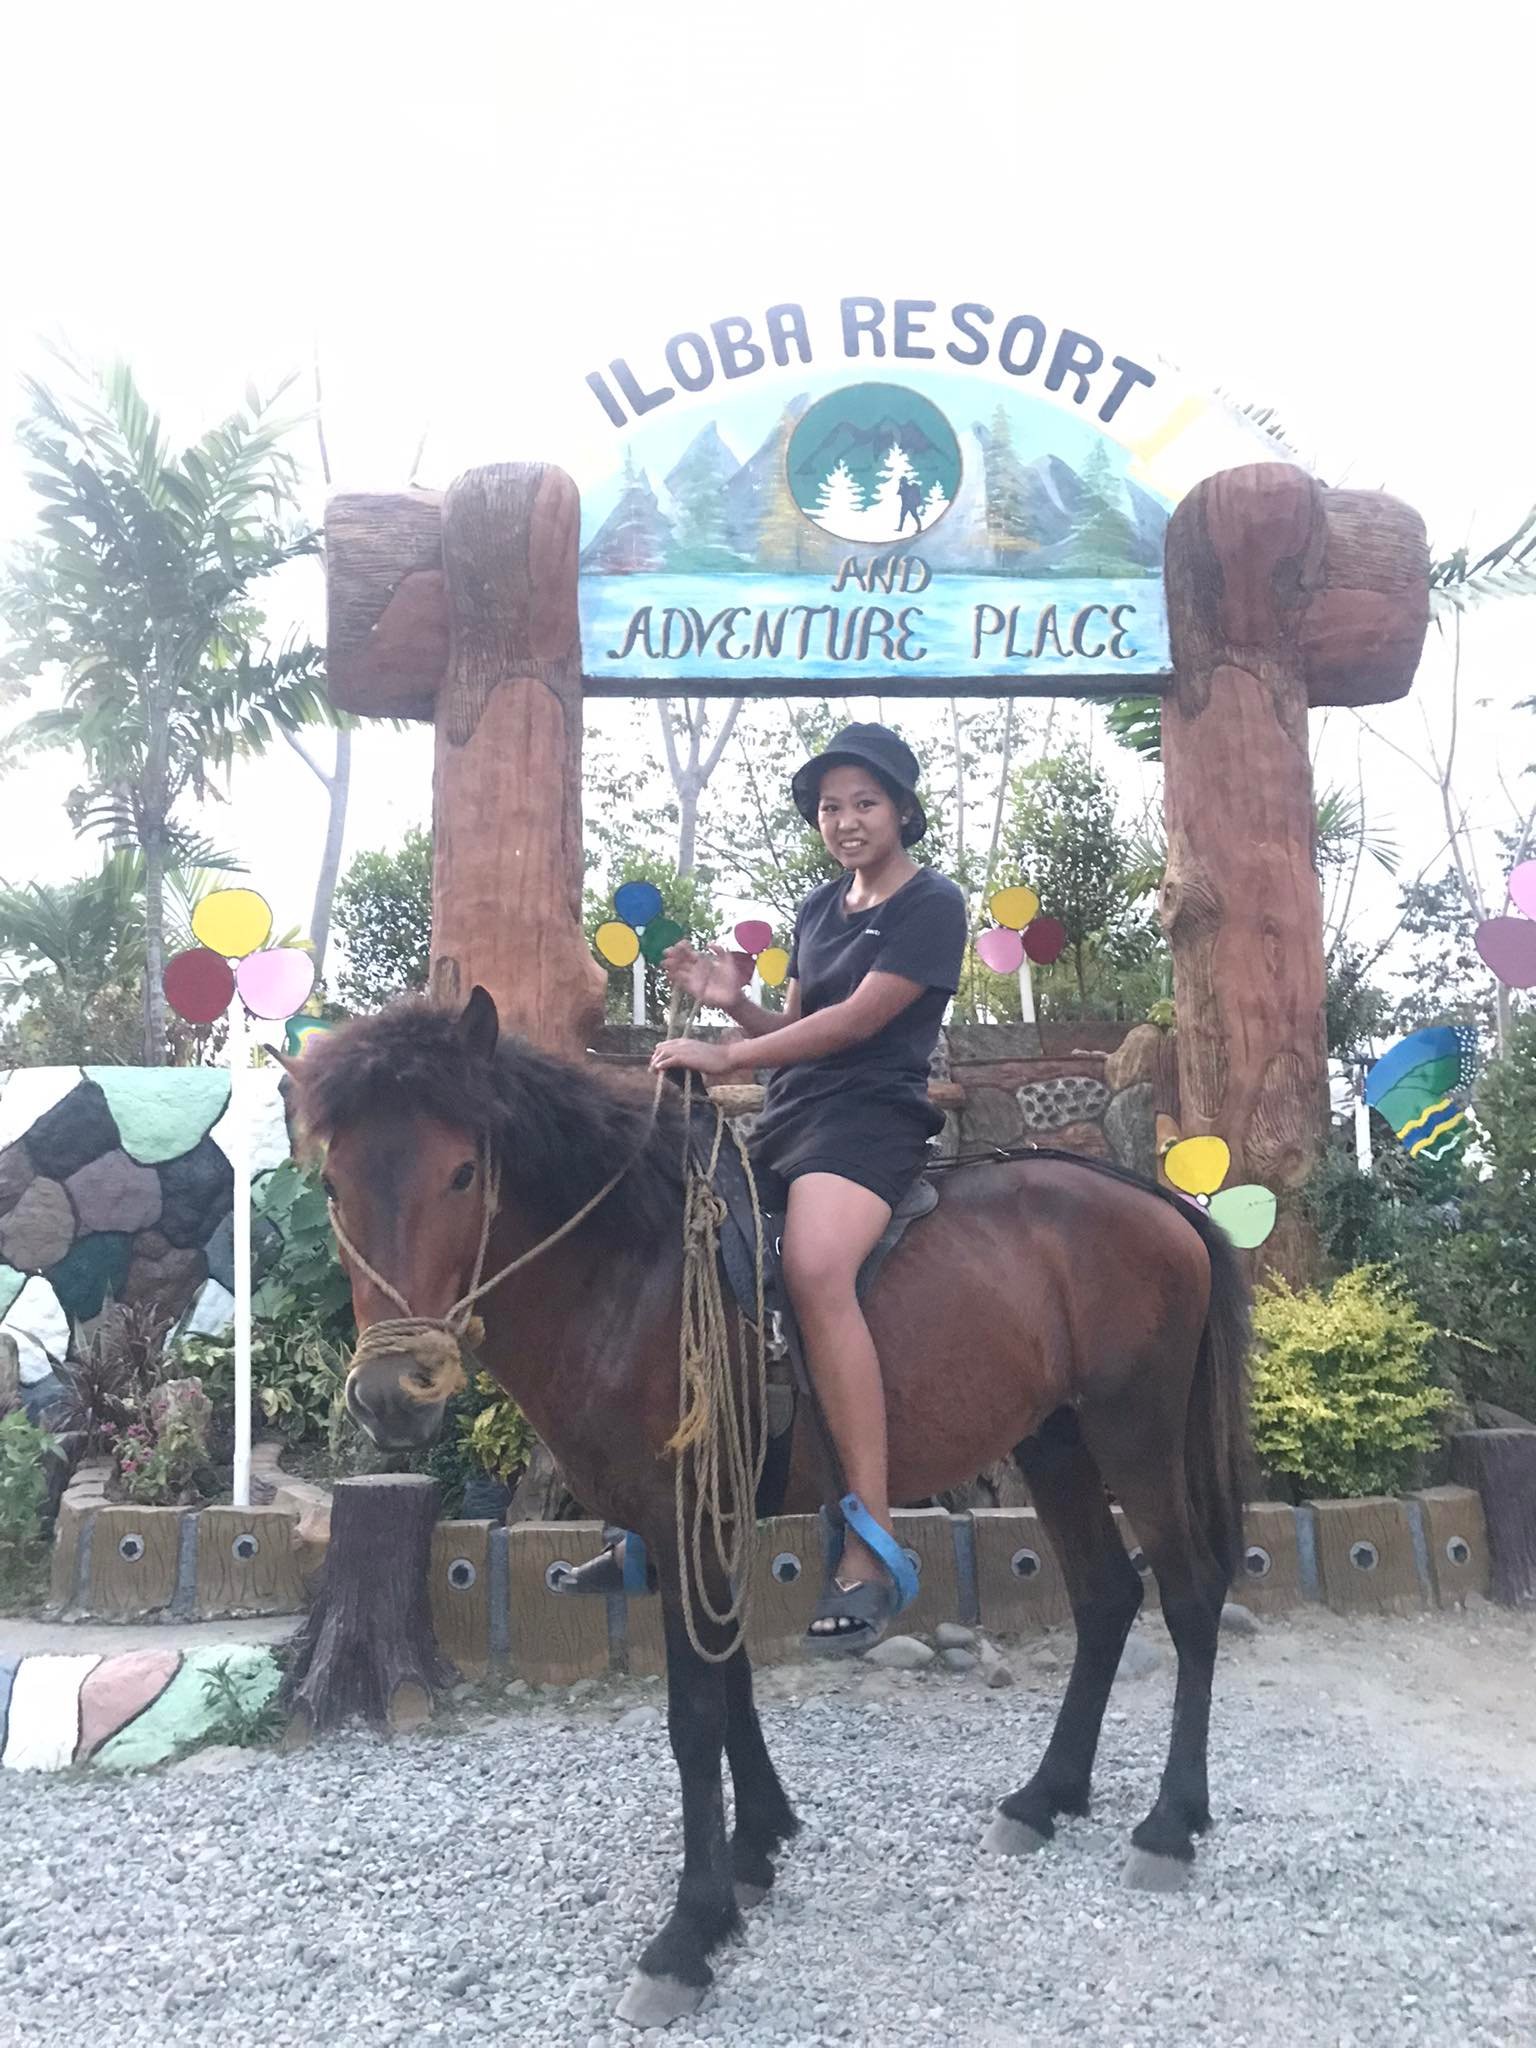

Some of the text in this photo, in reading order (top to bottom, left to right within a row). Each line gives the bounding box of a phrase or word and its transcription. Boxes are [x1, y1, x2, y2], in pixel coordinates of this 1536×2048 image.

[586, 296, 1156, 427] ILOBA RESORT
[831, 555, 933, 594] AND
[607, 603, 1138, 661] ADVENTURE PLACE
